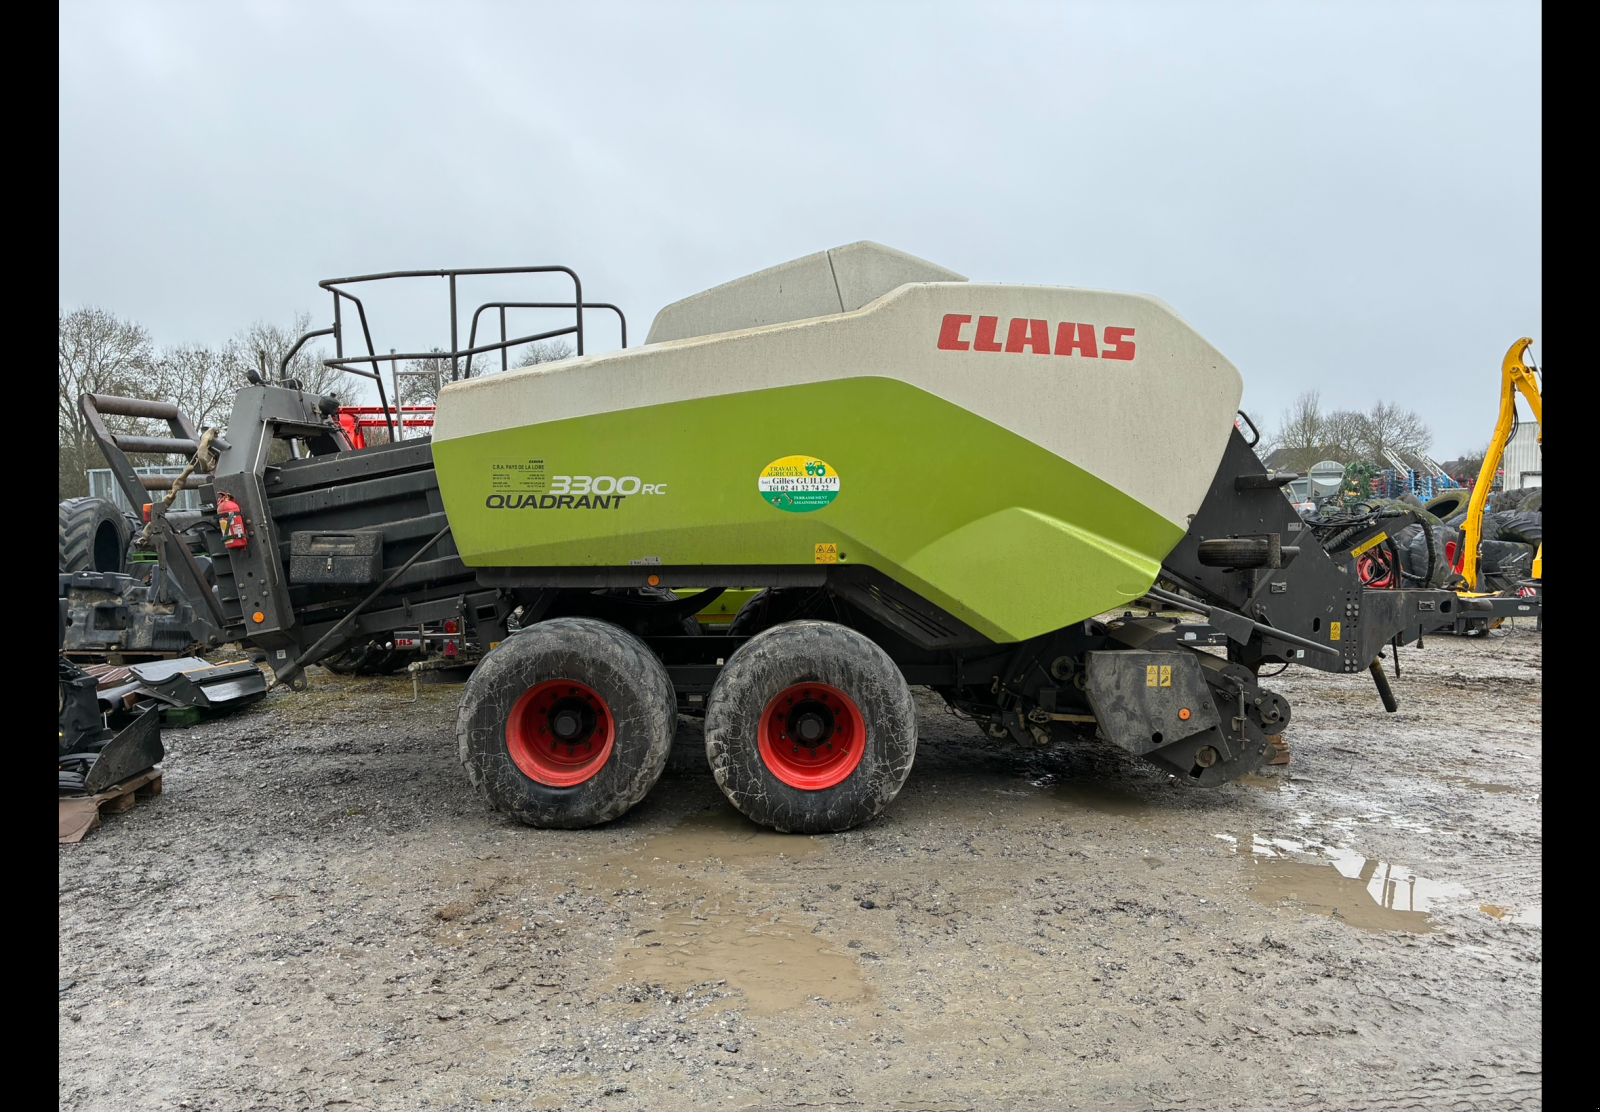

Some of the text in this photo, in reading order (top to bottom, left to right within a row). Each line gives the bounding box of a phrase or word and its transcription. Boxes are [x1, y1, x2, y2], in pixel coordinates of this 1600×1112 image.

[937, 313, 1136, 362] CLAAS
[549, 475, 667, 495] 3300 RC
[485, 494, 626, 510] QUADRANT
